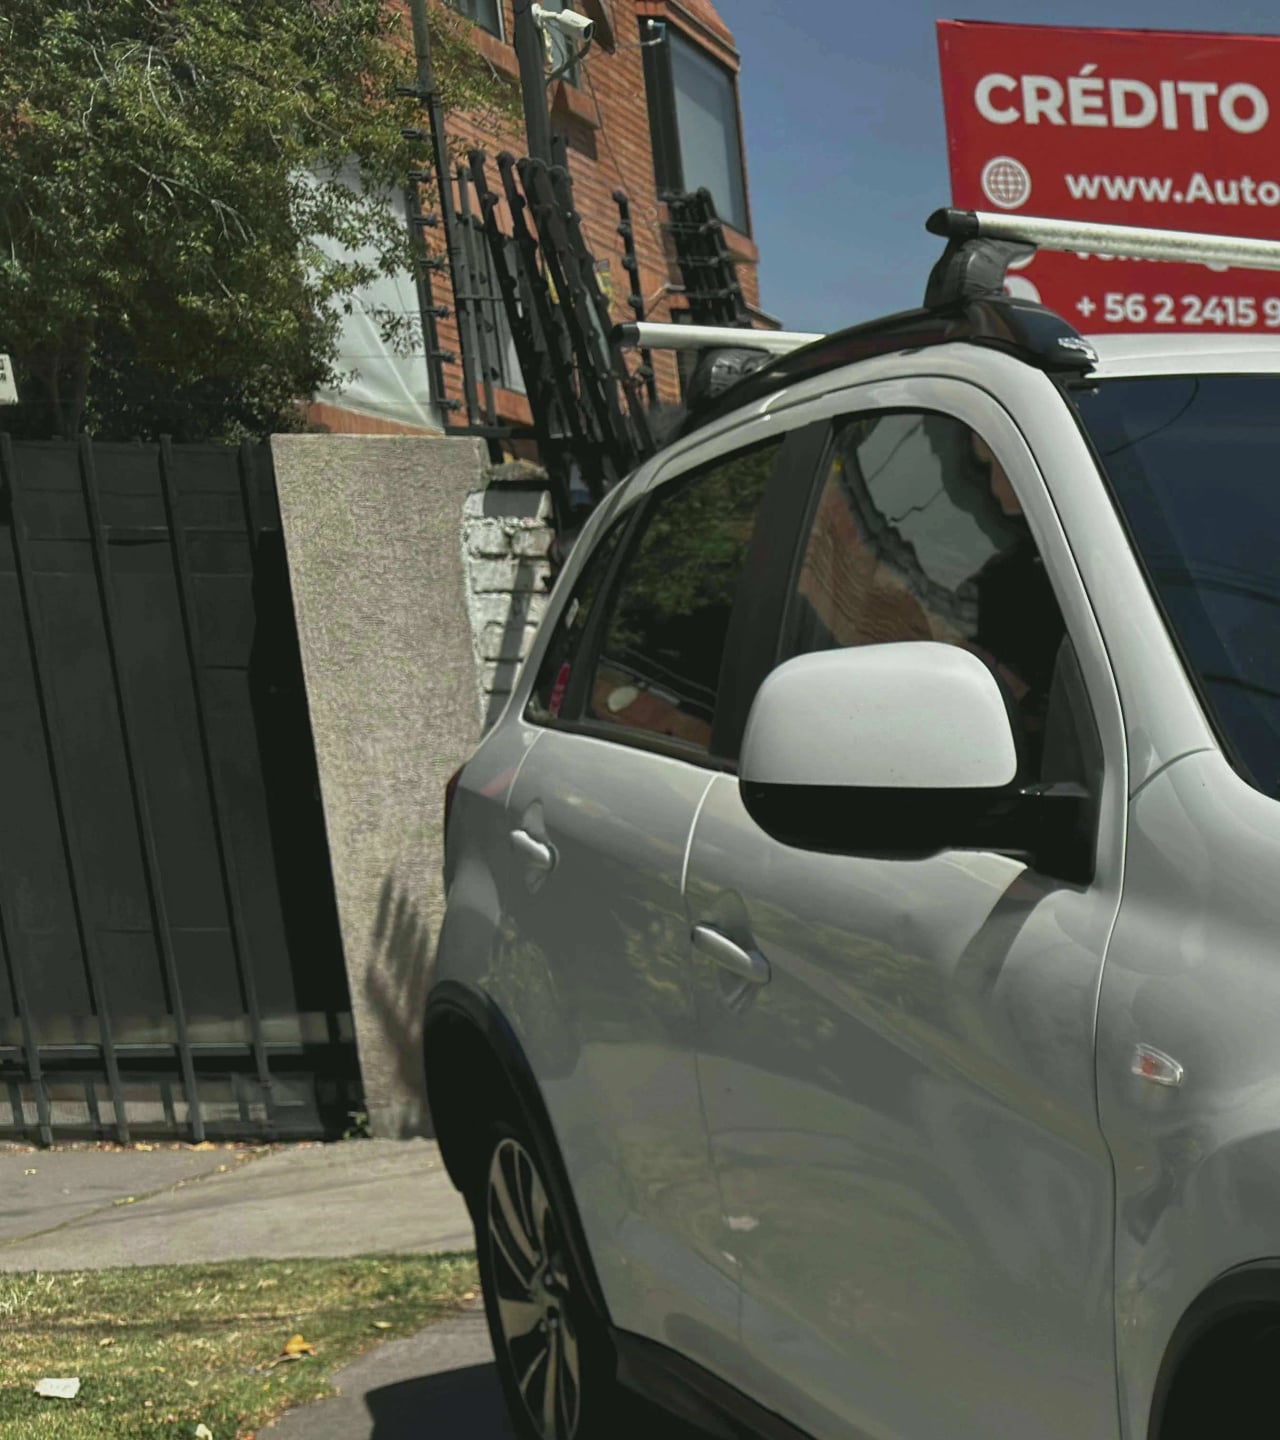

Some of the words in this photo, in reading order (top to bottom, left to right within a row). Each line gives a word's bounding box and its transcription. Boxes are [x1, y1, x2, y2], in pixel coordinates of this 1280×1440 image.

[974, 63, 1270, 134] CRÉDITO
[1104, 292, 1147, 323] 56
[1153, 293, 1176, 324] 2
[1181, 294, 1257, 327] 2415
